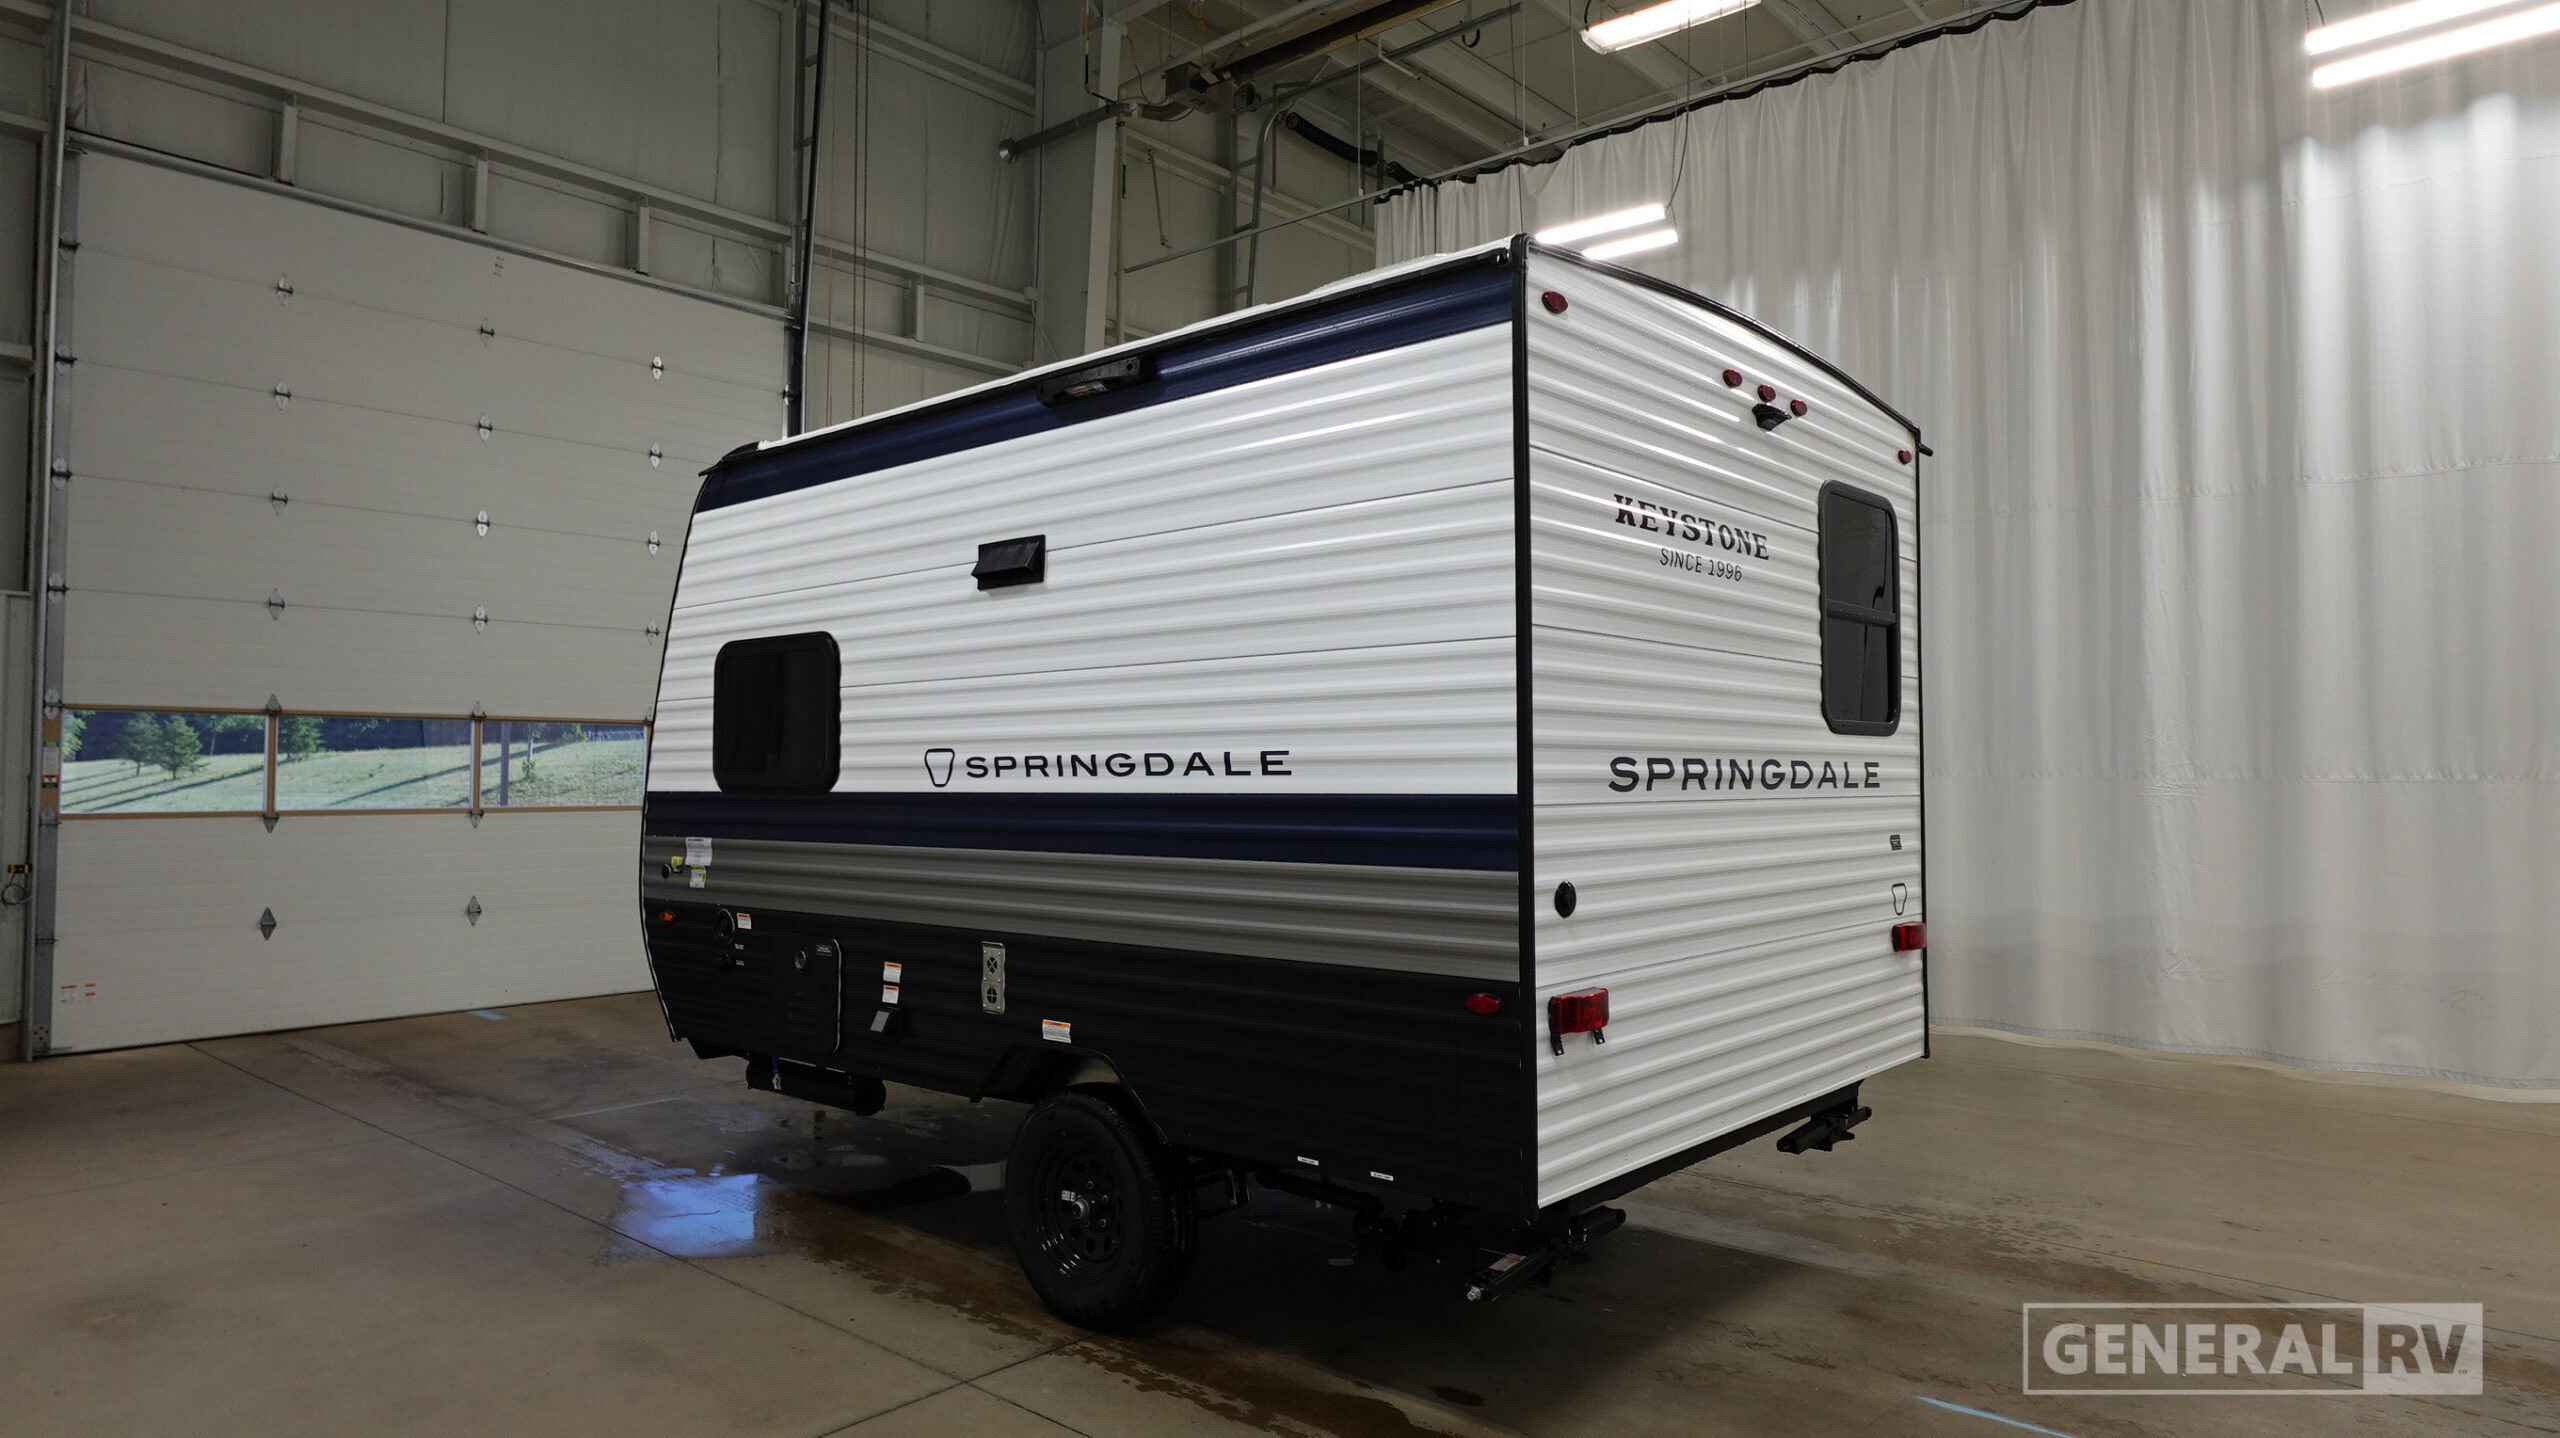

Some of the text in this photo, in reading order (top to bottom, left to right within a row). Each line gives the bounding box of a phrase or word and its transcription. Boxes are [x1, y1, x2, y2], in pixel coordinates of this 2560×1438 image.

[1613, 493, 1770, 561] KEYSTONE
[1659, 547, 1743, 582] SINCE 1996
[965, 750, 1293, 779] SPRINGDALE
[1608, 756, 1881, 793] SPRINGDALE
